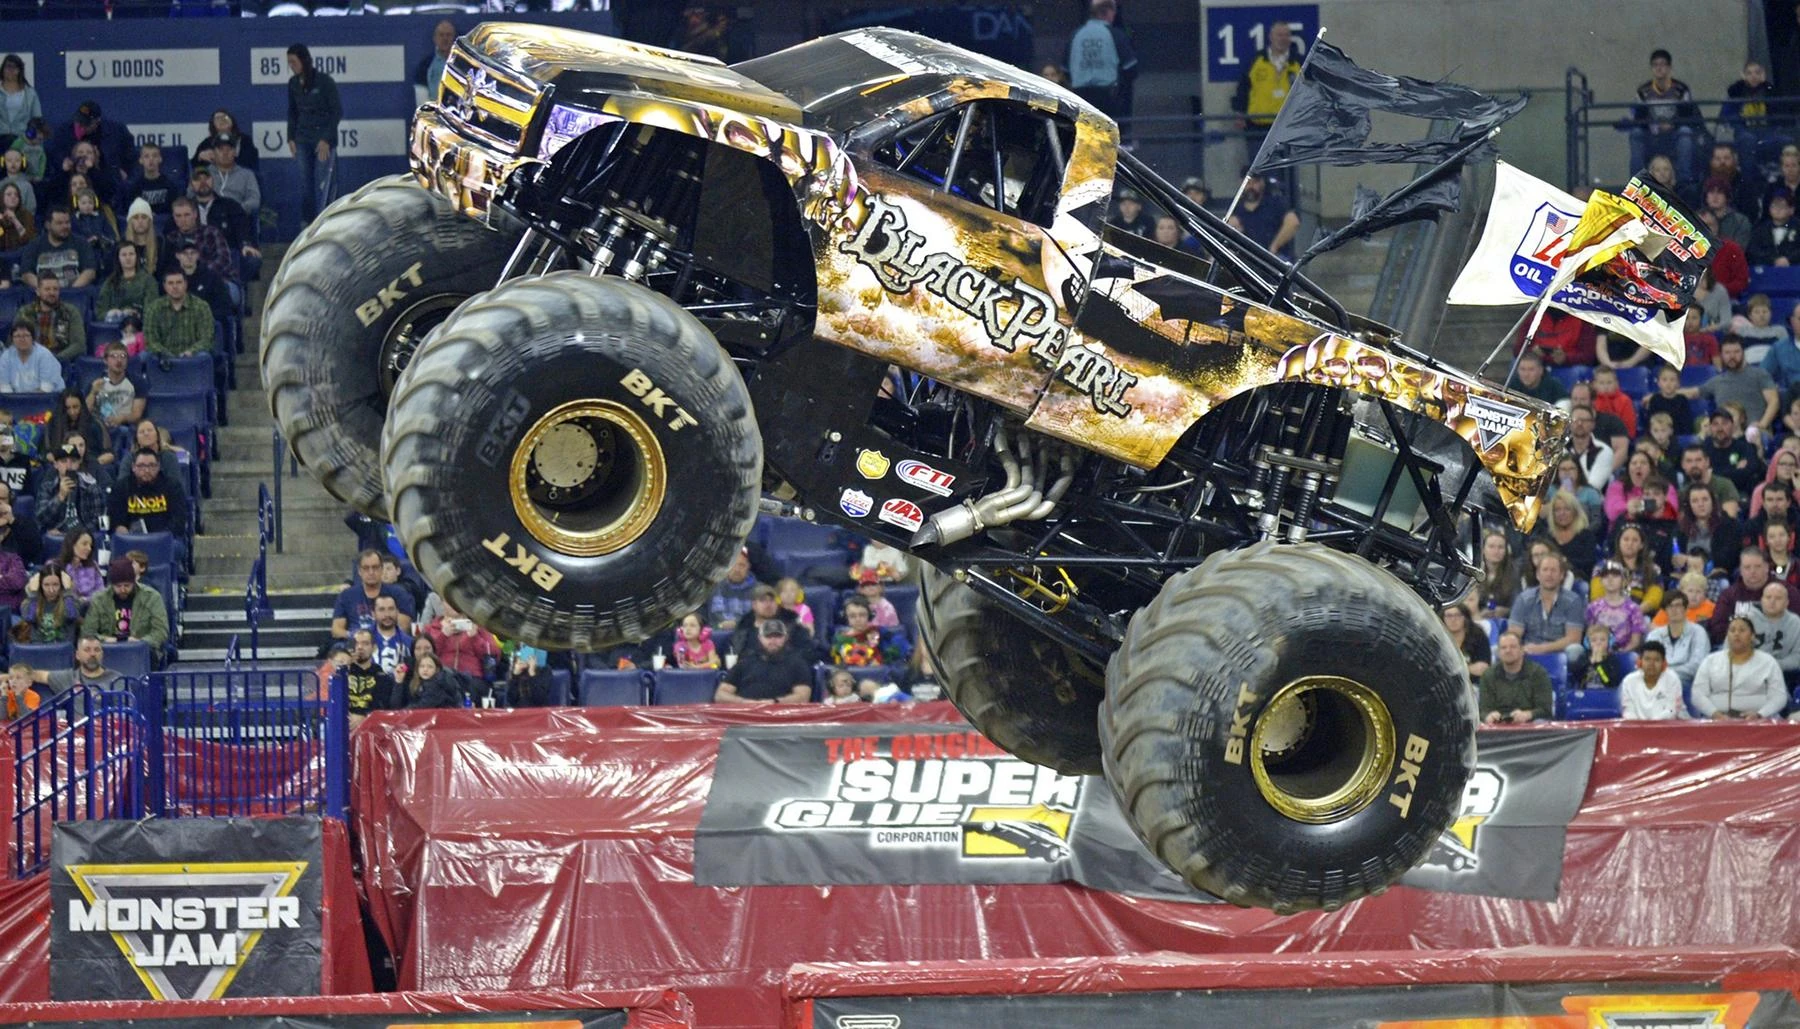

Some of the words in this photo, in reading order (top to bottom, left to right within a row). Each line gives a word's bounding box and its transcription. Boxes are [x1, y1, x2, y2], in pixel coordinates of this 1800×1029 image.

[112, 59, 164, 78] DODDS
[261, 57, 281, 75] 85
[1513, 262, 1542, 284] OIL
[355, 261, 424, 328] BKT
[1560, 281, 1649, 321] RODUCTS
[619, 367, 699, 432] BKT
[1480, 419, 1510, 435] JAM
[905, 464, 954, 487] FTI
[128, 495, 167, 508] UNOH
[481, 532, 564, 592] BKT
[1223, 682, 1257, 765] BKT
[825, 736, 880, 764] THE
[840, 757, 1080, 806] SUPER
[1388, 733, 1430, 819] BKT
[778, 801, 964, 828] GLUE
[877, 831, 959, 844] CORPORATION
[68, 895, 301, 932] MONSTER
[133, 932, 237, 967] JAM
